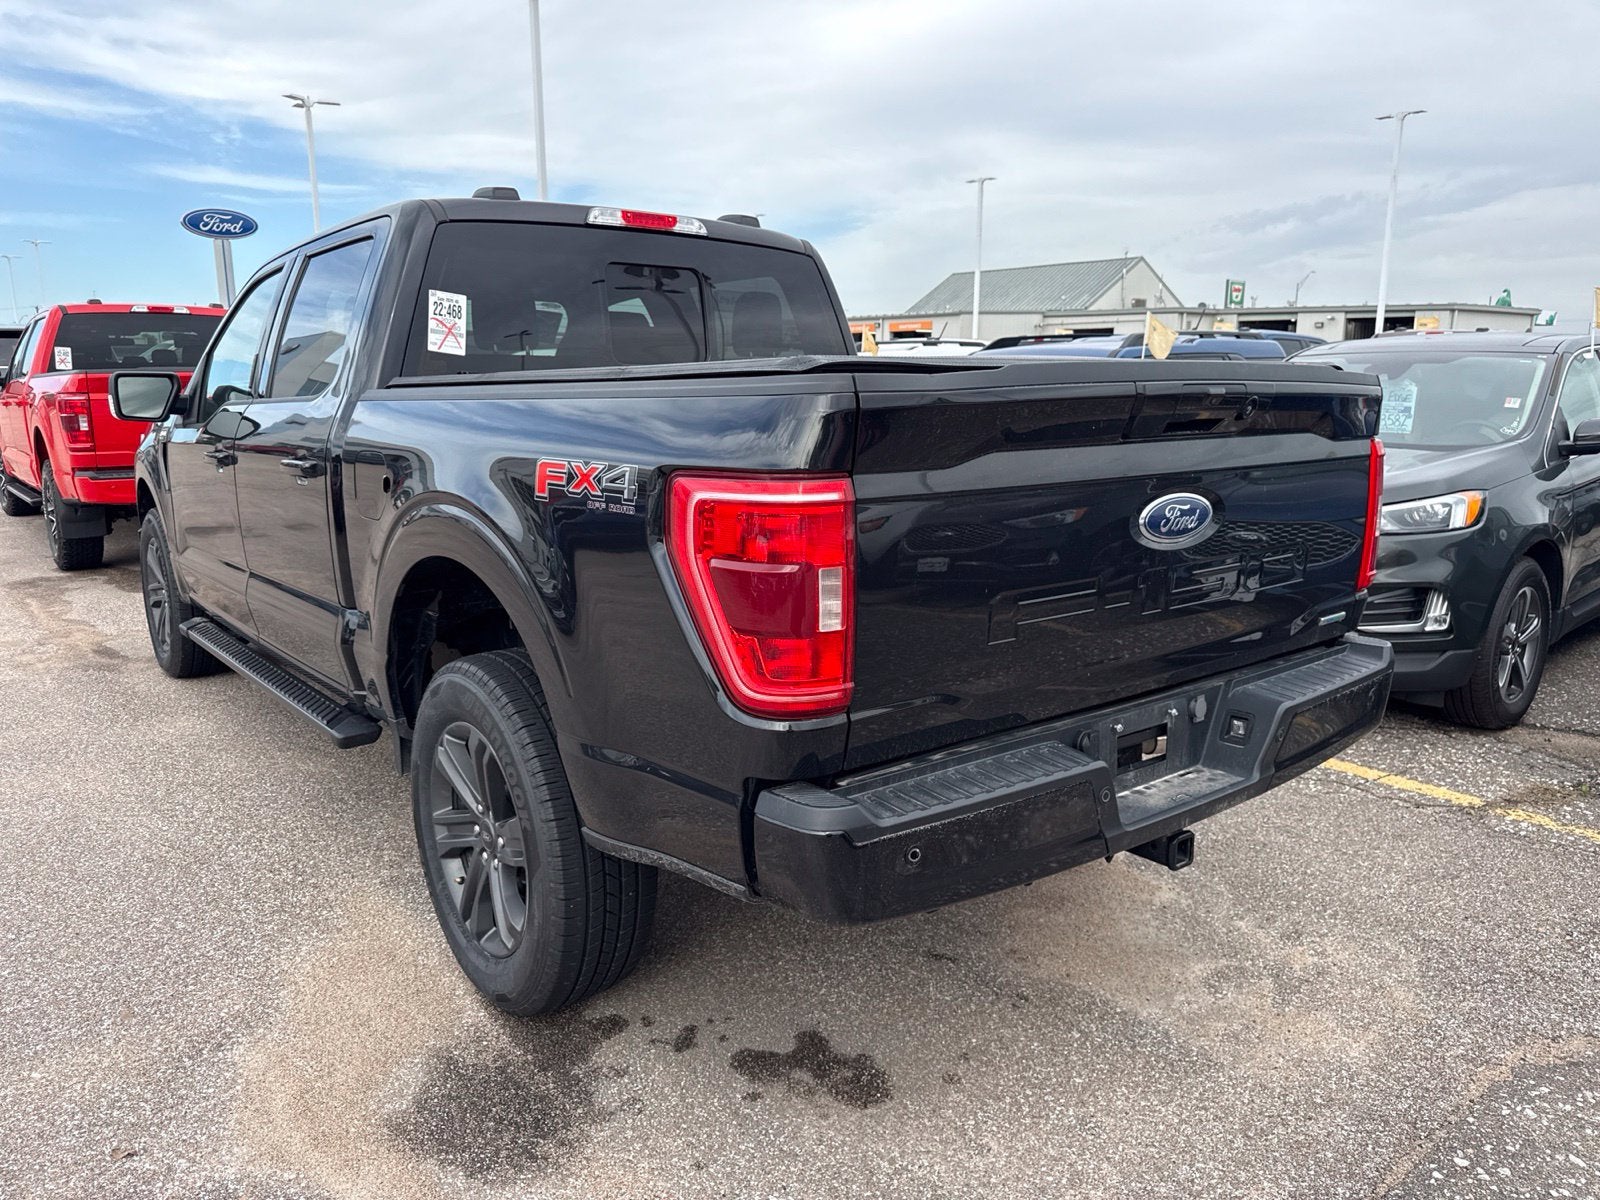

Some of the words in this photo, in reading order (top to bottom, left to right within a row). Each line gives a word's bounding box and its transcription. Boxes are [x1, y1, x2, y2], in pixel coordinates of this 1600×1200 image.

[199, 213, 243, 233] Ford
[433, 301, 463, 320] 22:468
[534, 456, 639, 505] FX4
[587, 501, 607, 510] OFF
[608, 503, 636, 515] ROAD
[1160, 504, 1200, 533] Ford
